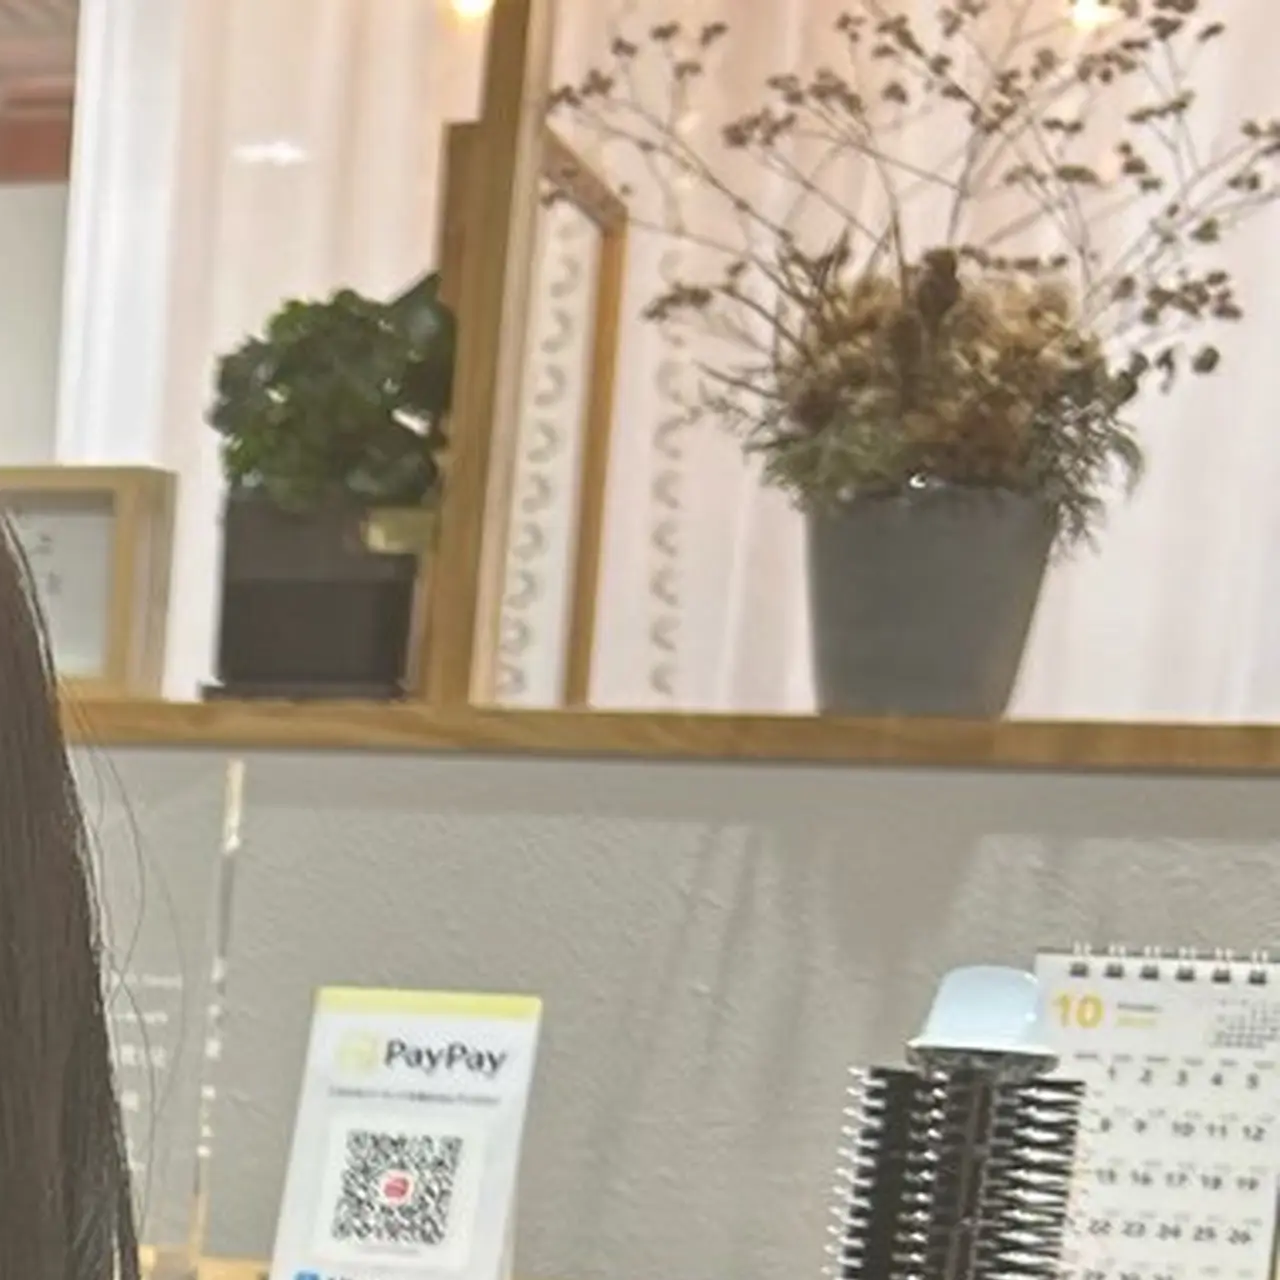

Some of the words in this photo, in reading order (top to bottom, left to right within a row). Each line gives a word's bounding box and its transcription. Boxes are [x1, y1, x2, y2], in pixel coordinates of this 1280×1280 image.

[1051, 994, 1105, 1029] 10
[384, 1037, 509, 1079] PayPay
[1139, 1069, 1153, 1086] 2
[1172, 1121, 1195, 1138] 10
[1207, 1123, 1227, 1138] 11
[1242, 1125, 1266, 1142] 12
